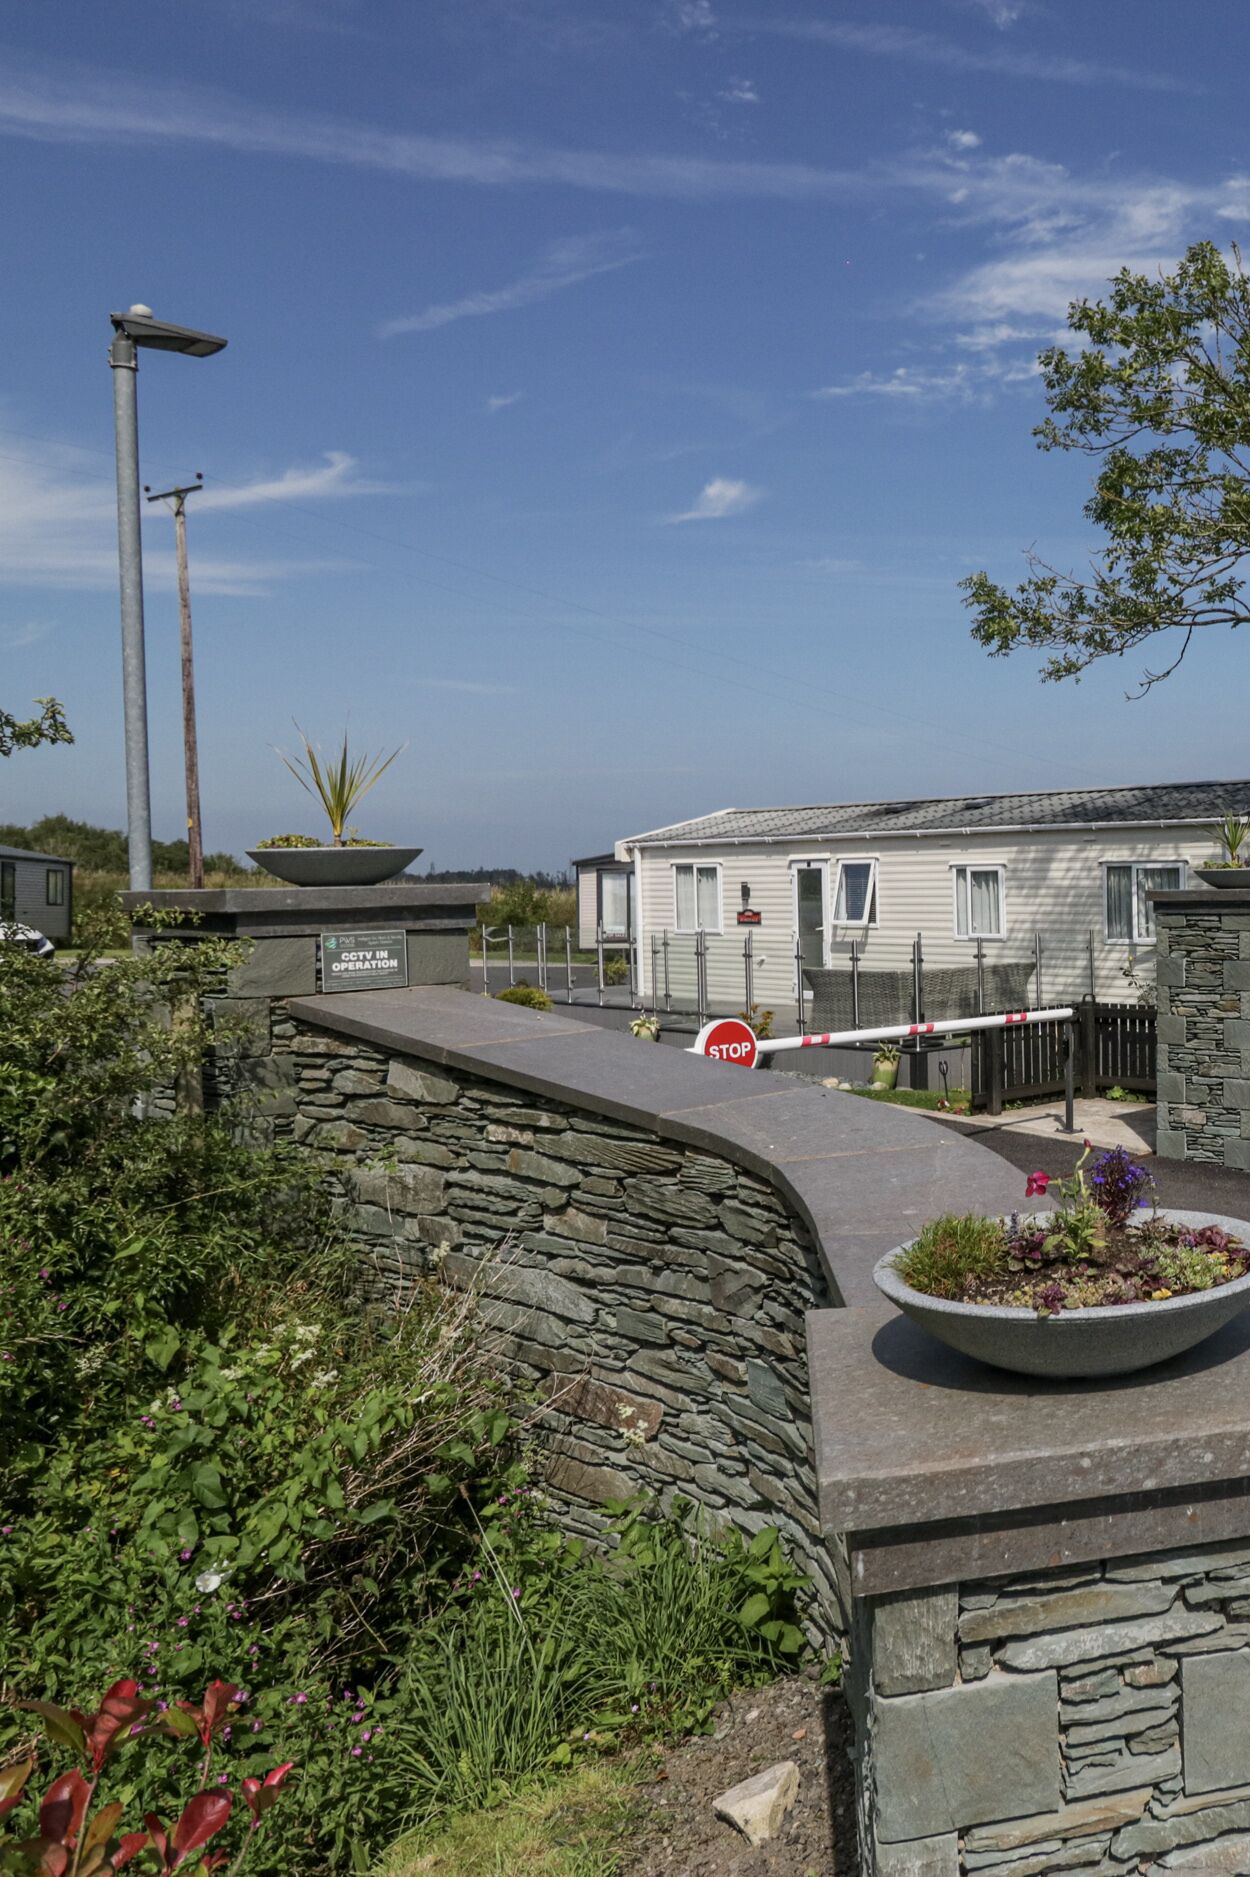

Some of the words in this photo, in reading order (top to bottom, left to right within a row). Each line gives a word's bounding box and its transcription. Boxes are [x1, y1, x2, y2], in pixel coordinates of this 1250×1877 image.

[341, 951, 373, 961] CCTV
[375, 950, 388, 959] IN
[332, 959, 398, 971] OPERATION
[709, 1042, 751, 1059] STOP
